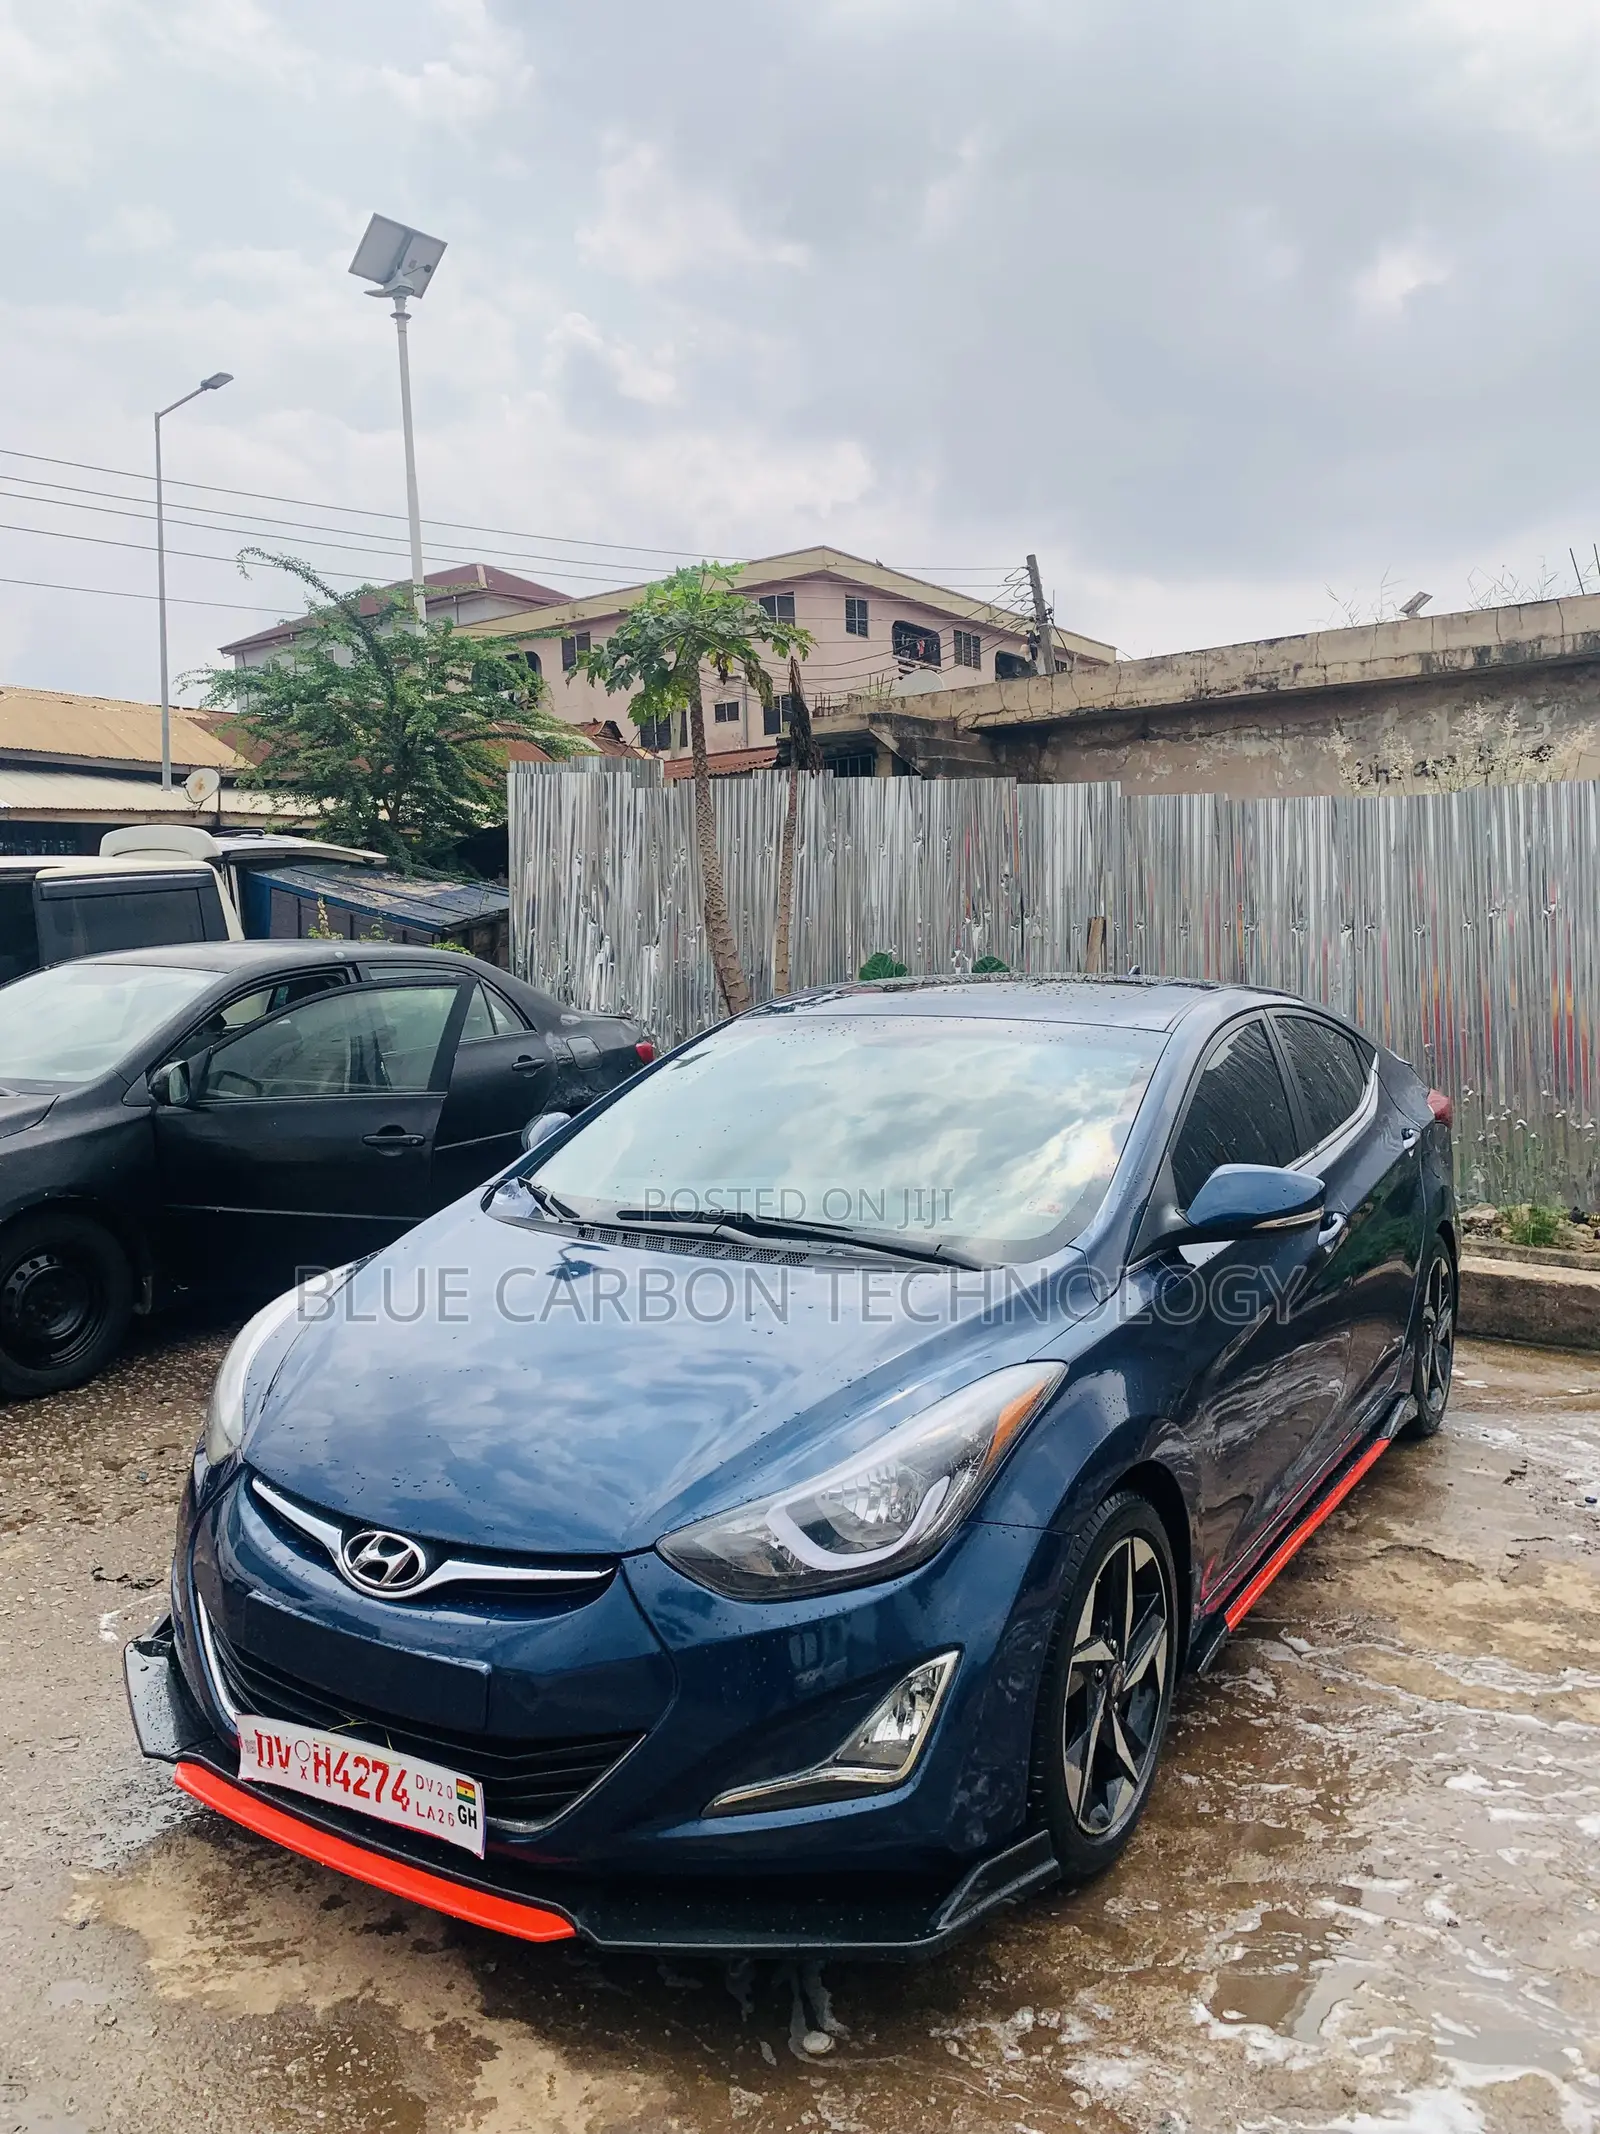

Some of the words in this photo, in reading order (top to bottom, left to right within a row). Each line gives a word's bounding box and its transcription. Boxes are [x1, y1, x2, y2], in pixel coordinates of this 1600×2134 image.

[313, 1744, 410, 1812] H4274
[415, 1774, 453, 1800] DV20
[458, 1805, 477, 1830] GH
